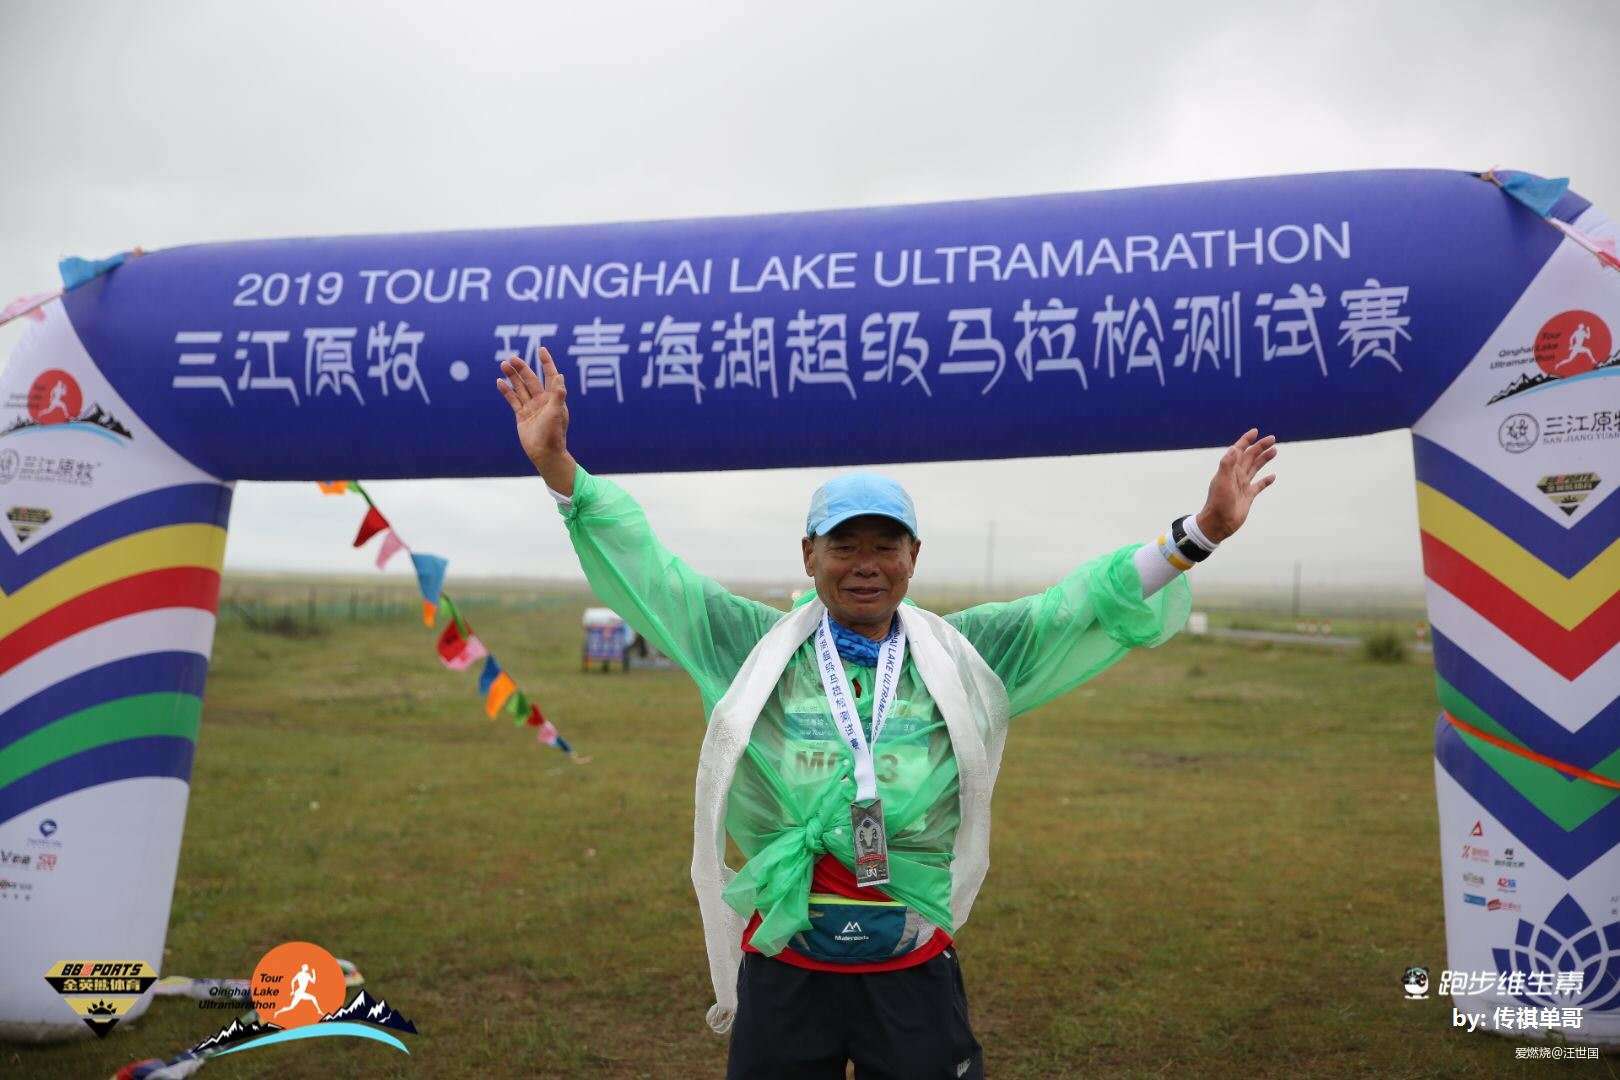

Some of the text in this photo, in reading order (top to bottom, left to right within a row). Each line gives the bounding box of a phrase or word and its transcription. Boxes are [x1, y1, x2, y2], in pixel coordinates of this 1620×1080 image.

[233, 221, 1351, 307] 2019 TOUR QINGHAI LAKE ULTRAMARATHON
[885, 647, 898, 674] LAKE
